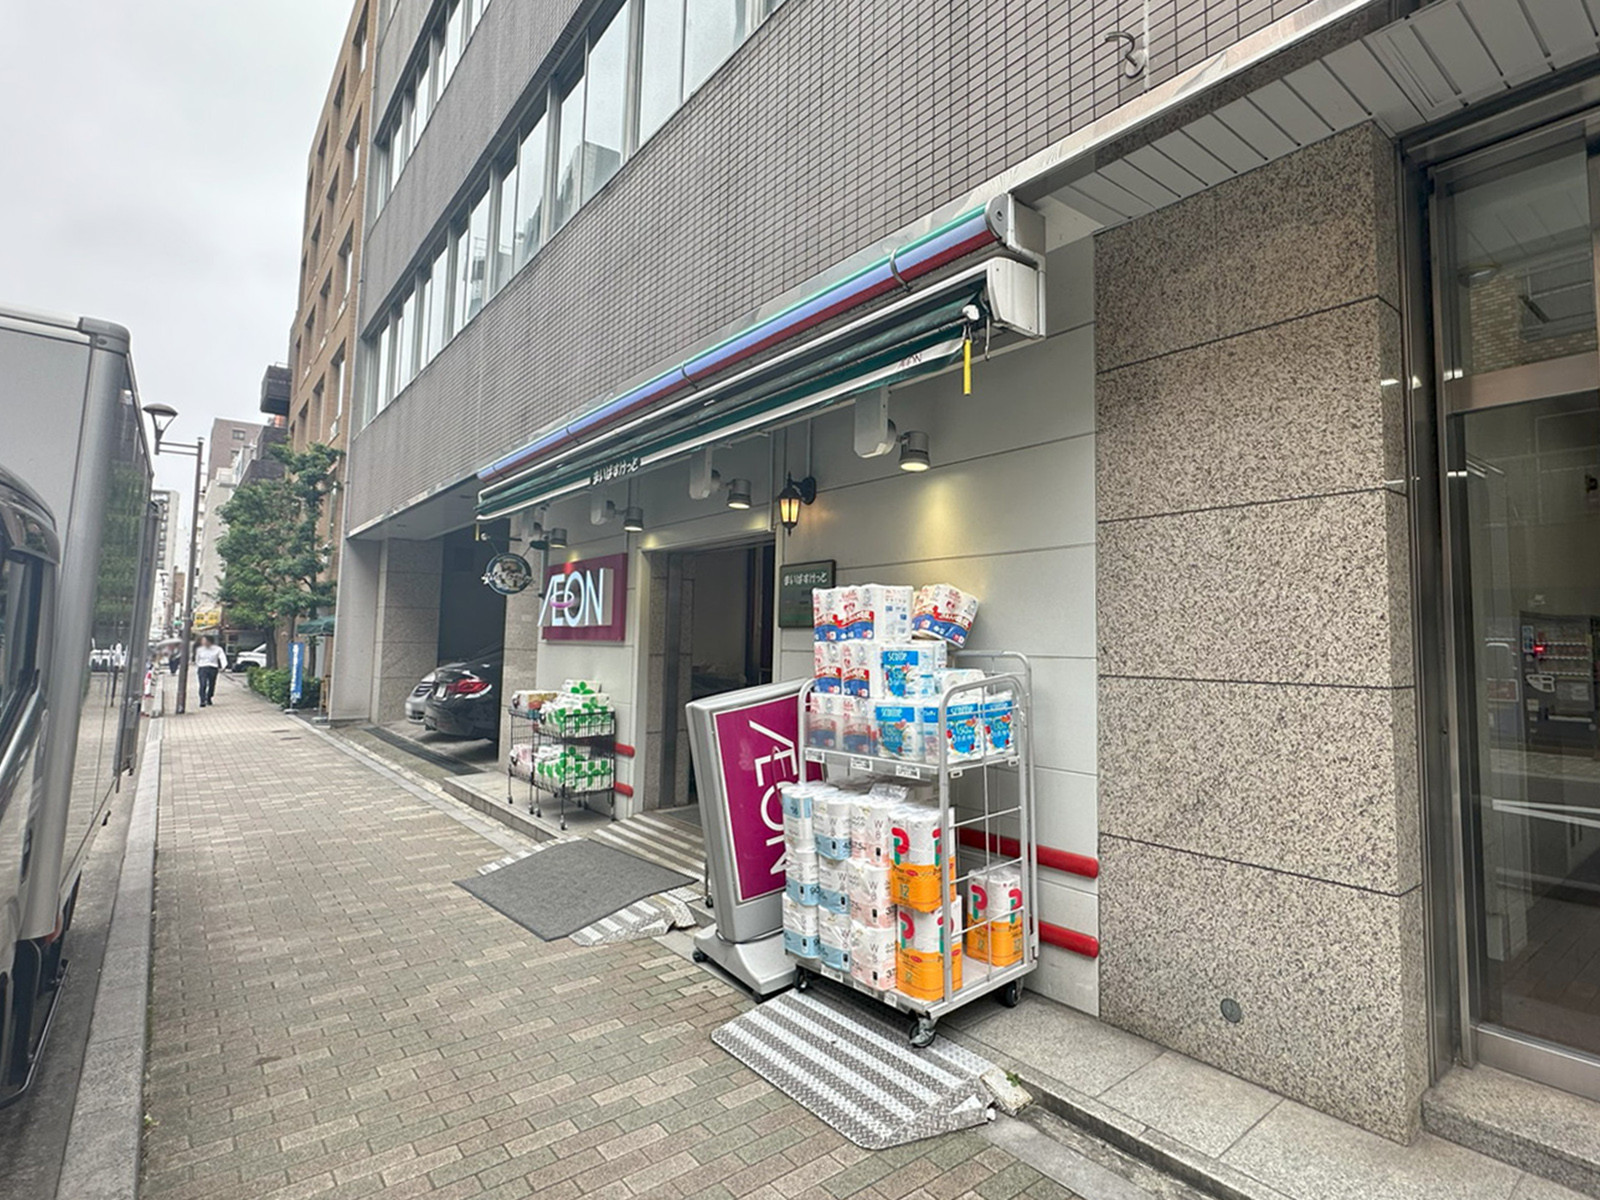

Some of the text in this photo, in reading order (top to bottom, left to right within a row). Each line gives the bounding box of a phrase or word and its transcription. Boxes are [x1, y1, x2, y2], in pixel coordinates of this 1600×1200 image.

[592, 456, 639, 486] まいばすけっと
[783, 571, 828, 587] まいばすけっと
